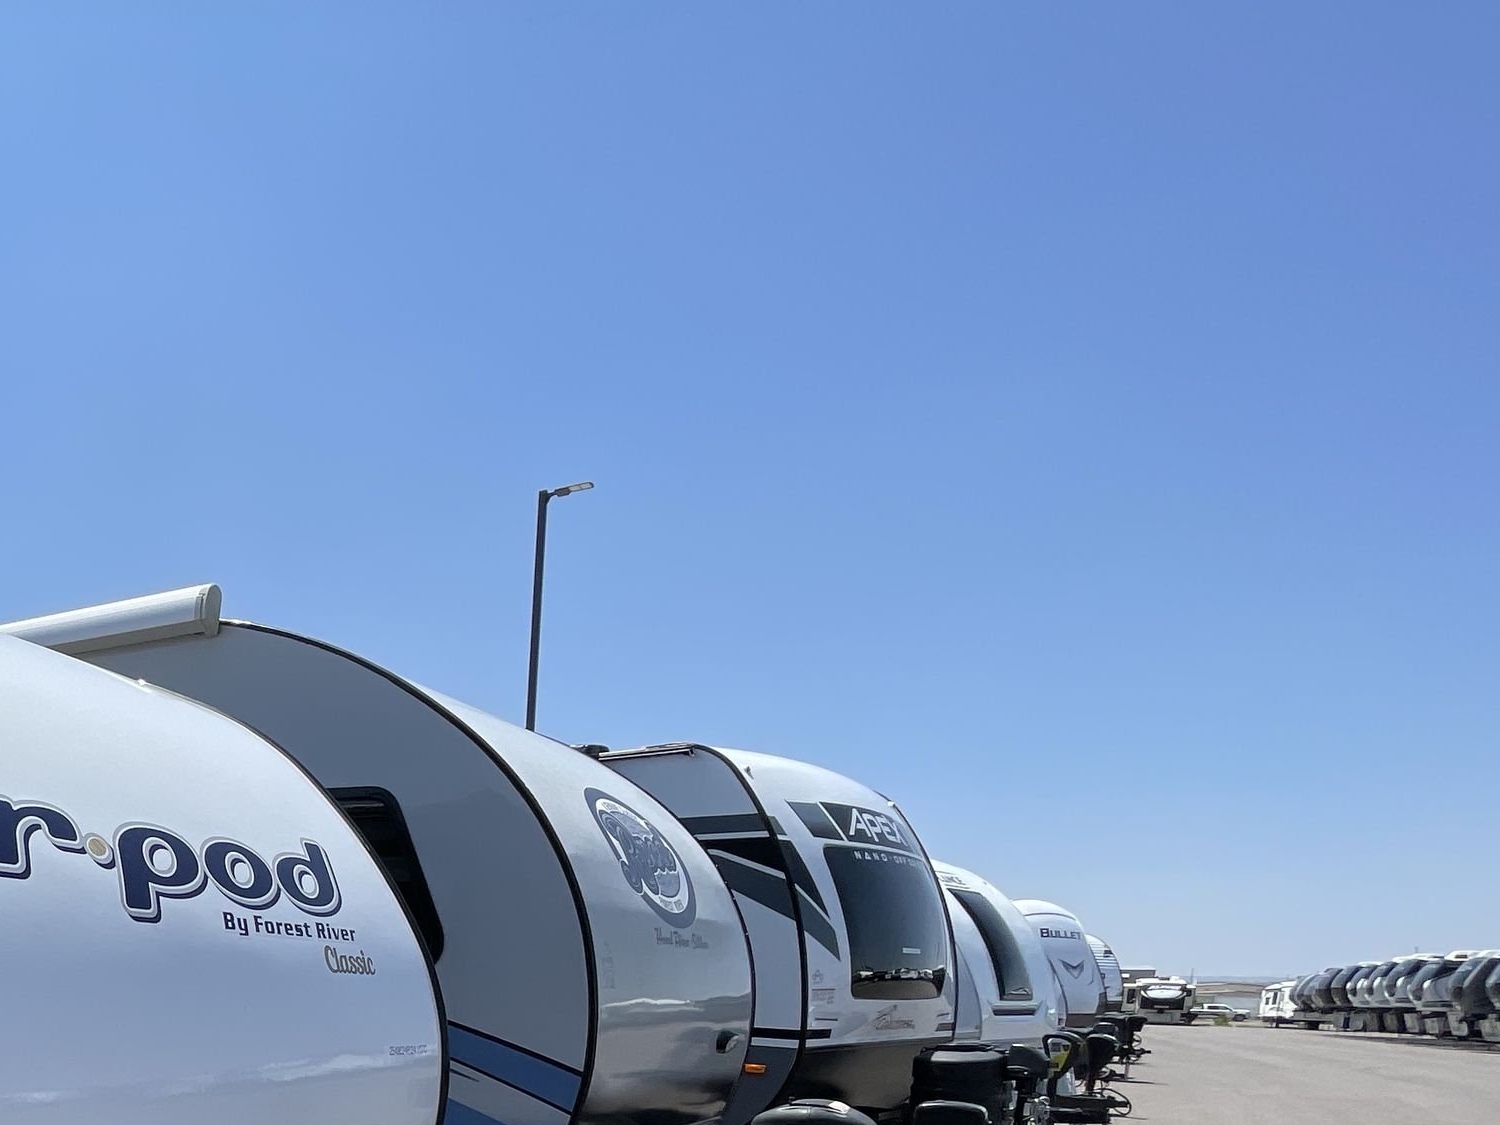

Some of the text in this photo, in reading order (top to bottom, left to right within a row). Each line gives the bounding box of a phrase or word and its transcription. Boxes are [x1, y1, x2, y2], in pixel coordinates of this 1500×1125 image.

[849, 808, 909, 846] APEX
[854, 851, 889, 862] NANO
[222, 911, 356, 942] By Forest River
[1040, 927, 1082, 940] BULLET
[323, 944, 376, 976] Classic
